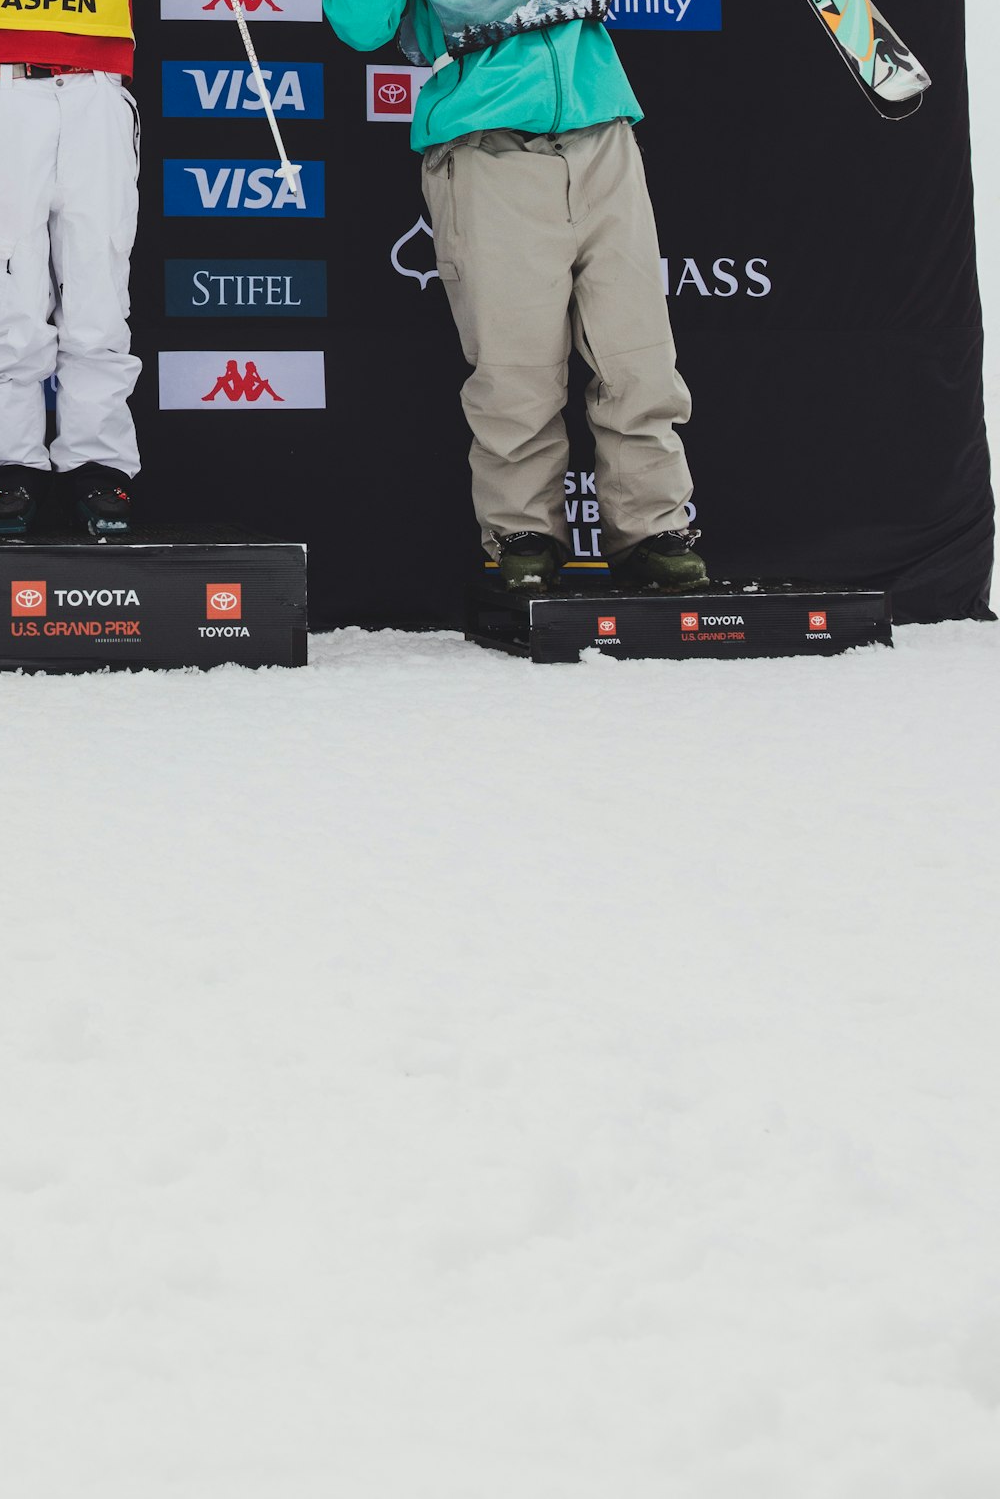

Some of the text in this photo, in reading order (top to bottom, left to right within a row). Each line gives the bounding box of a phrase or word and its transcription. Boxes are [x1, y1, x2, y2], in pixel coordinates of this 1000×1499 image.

[182, 69, 306, 111] VISA
[183, 167, 307, 210] VISA
[191, 270, 302, 306] STIFEL
[53, 589, 141, 607] TOYOTA
[11, 620, 142, 637] U.S. GRAND PRIX
[701, 615, 745, 626] TOYOTA
[198, 626, 251, 638] TOYOTA
[681, 631, 745, 641] U.S. GRAND PRIX
